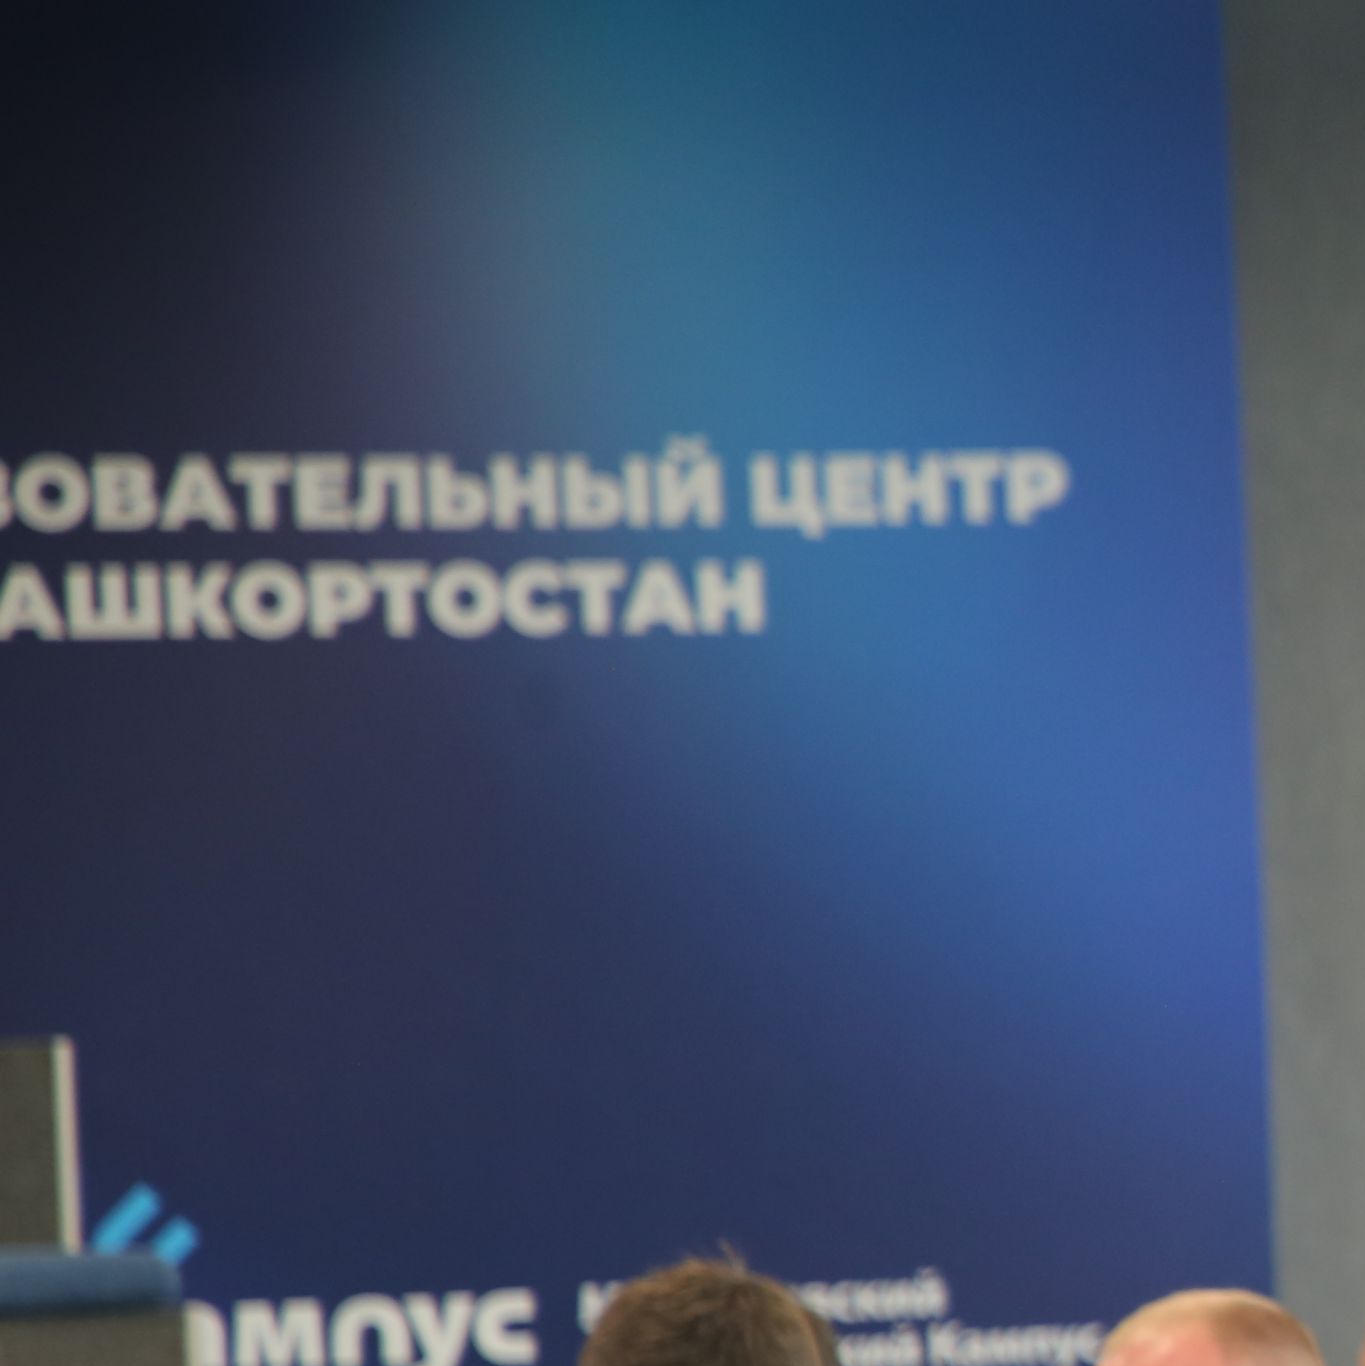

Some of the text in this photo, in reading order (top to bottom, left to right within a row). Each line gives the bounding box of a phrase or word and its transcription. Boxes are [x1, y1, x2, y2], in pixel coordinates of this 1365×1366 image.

[0, 436, 1070, 540] ОВАТЕЛЬНЫЙ ЦЕНТР
[0, 557, 765, 641] АШКОРТОСТАН
